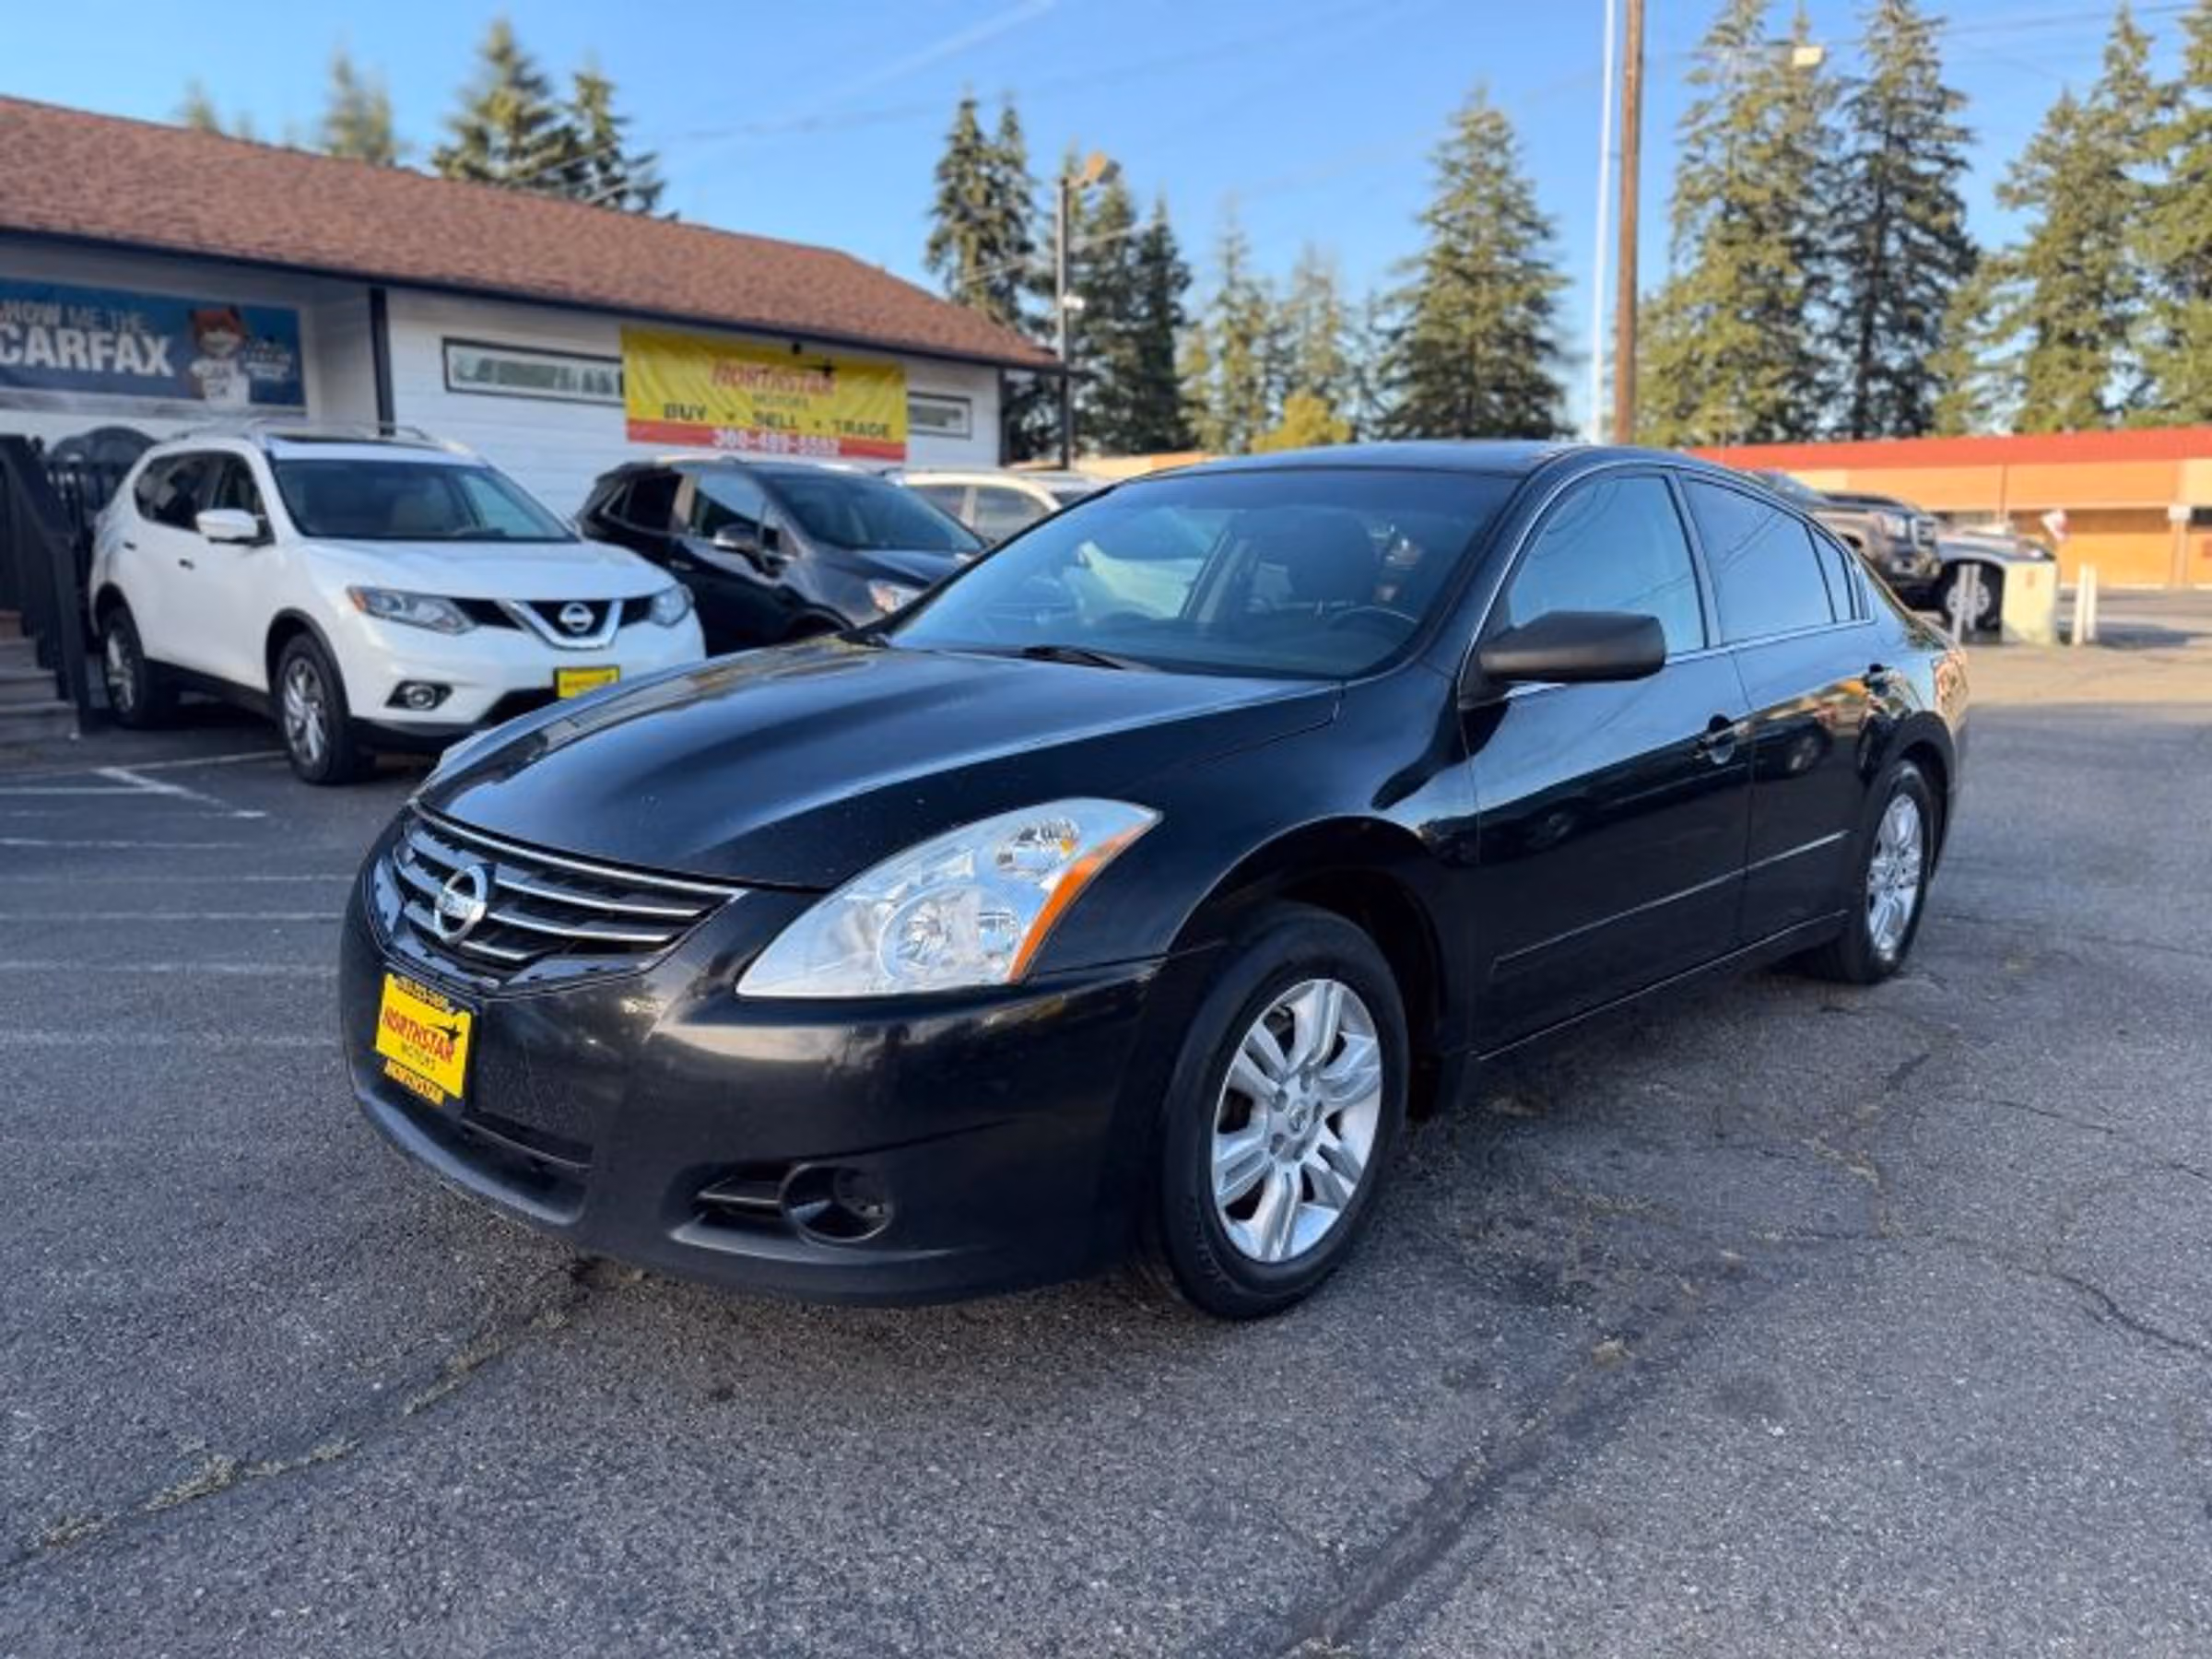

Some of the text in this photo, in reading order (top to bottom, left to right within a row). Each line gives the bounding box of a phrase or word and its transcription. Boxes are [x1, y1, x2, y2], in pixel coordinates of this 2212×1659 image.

[0, 300, 147, 334] HOW ME THE
[0, 323, 175, 378] CARFAX
[663, 402, 890, 440] BUY SELL TRADE
[382, 1004, 455, 1064] NORTHSTAR
